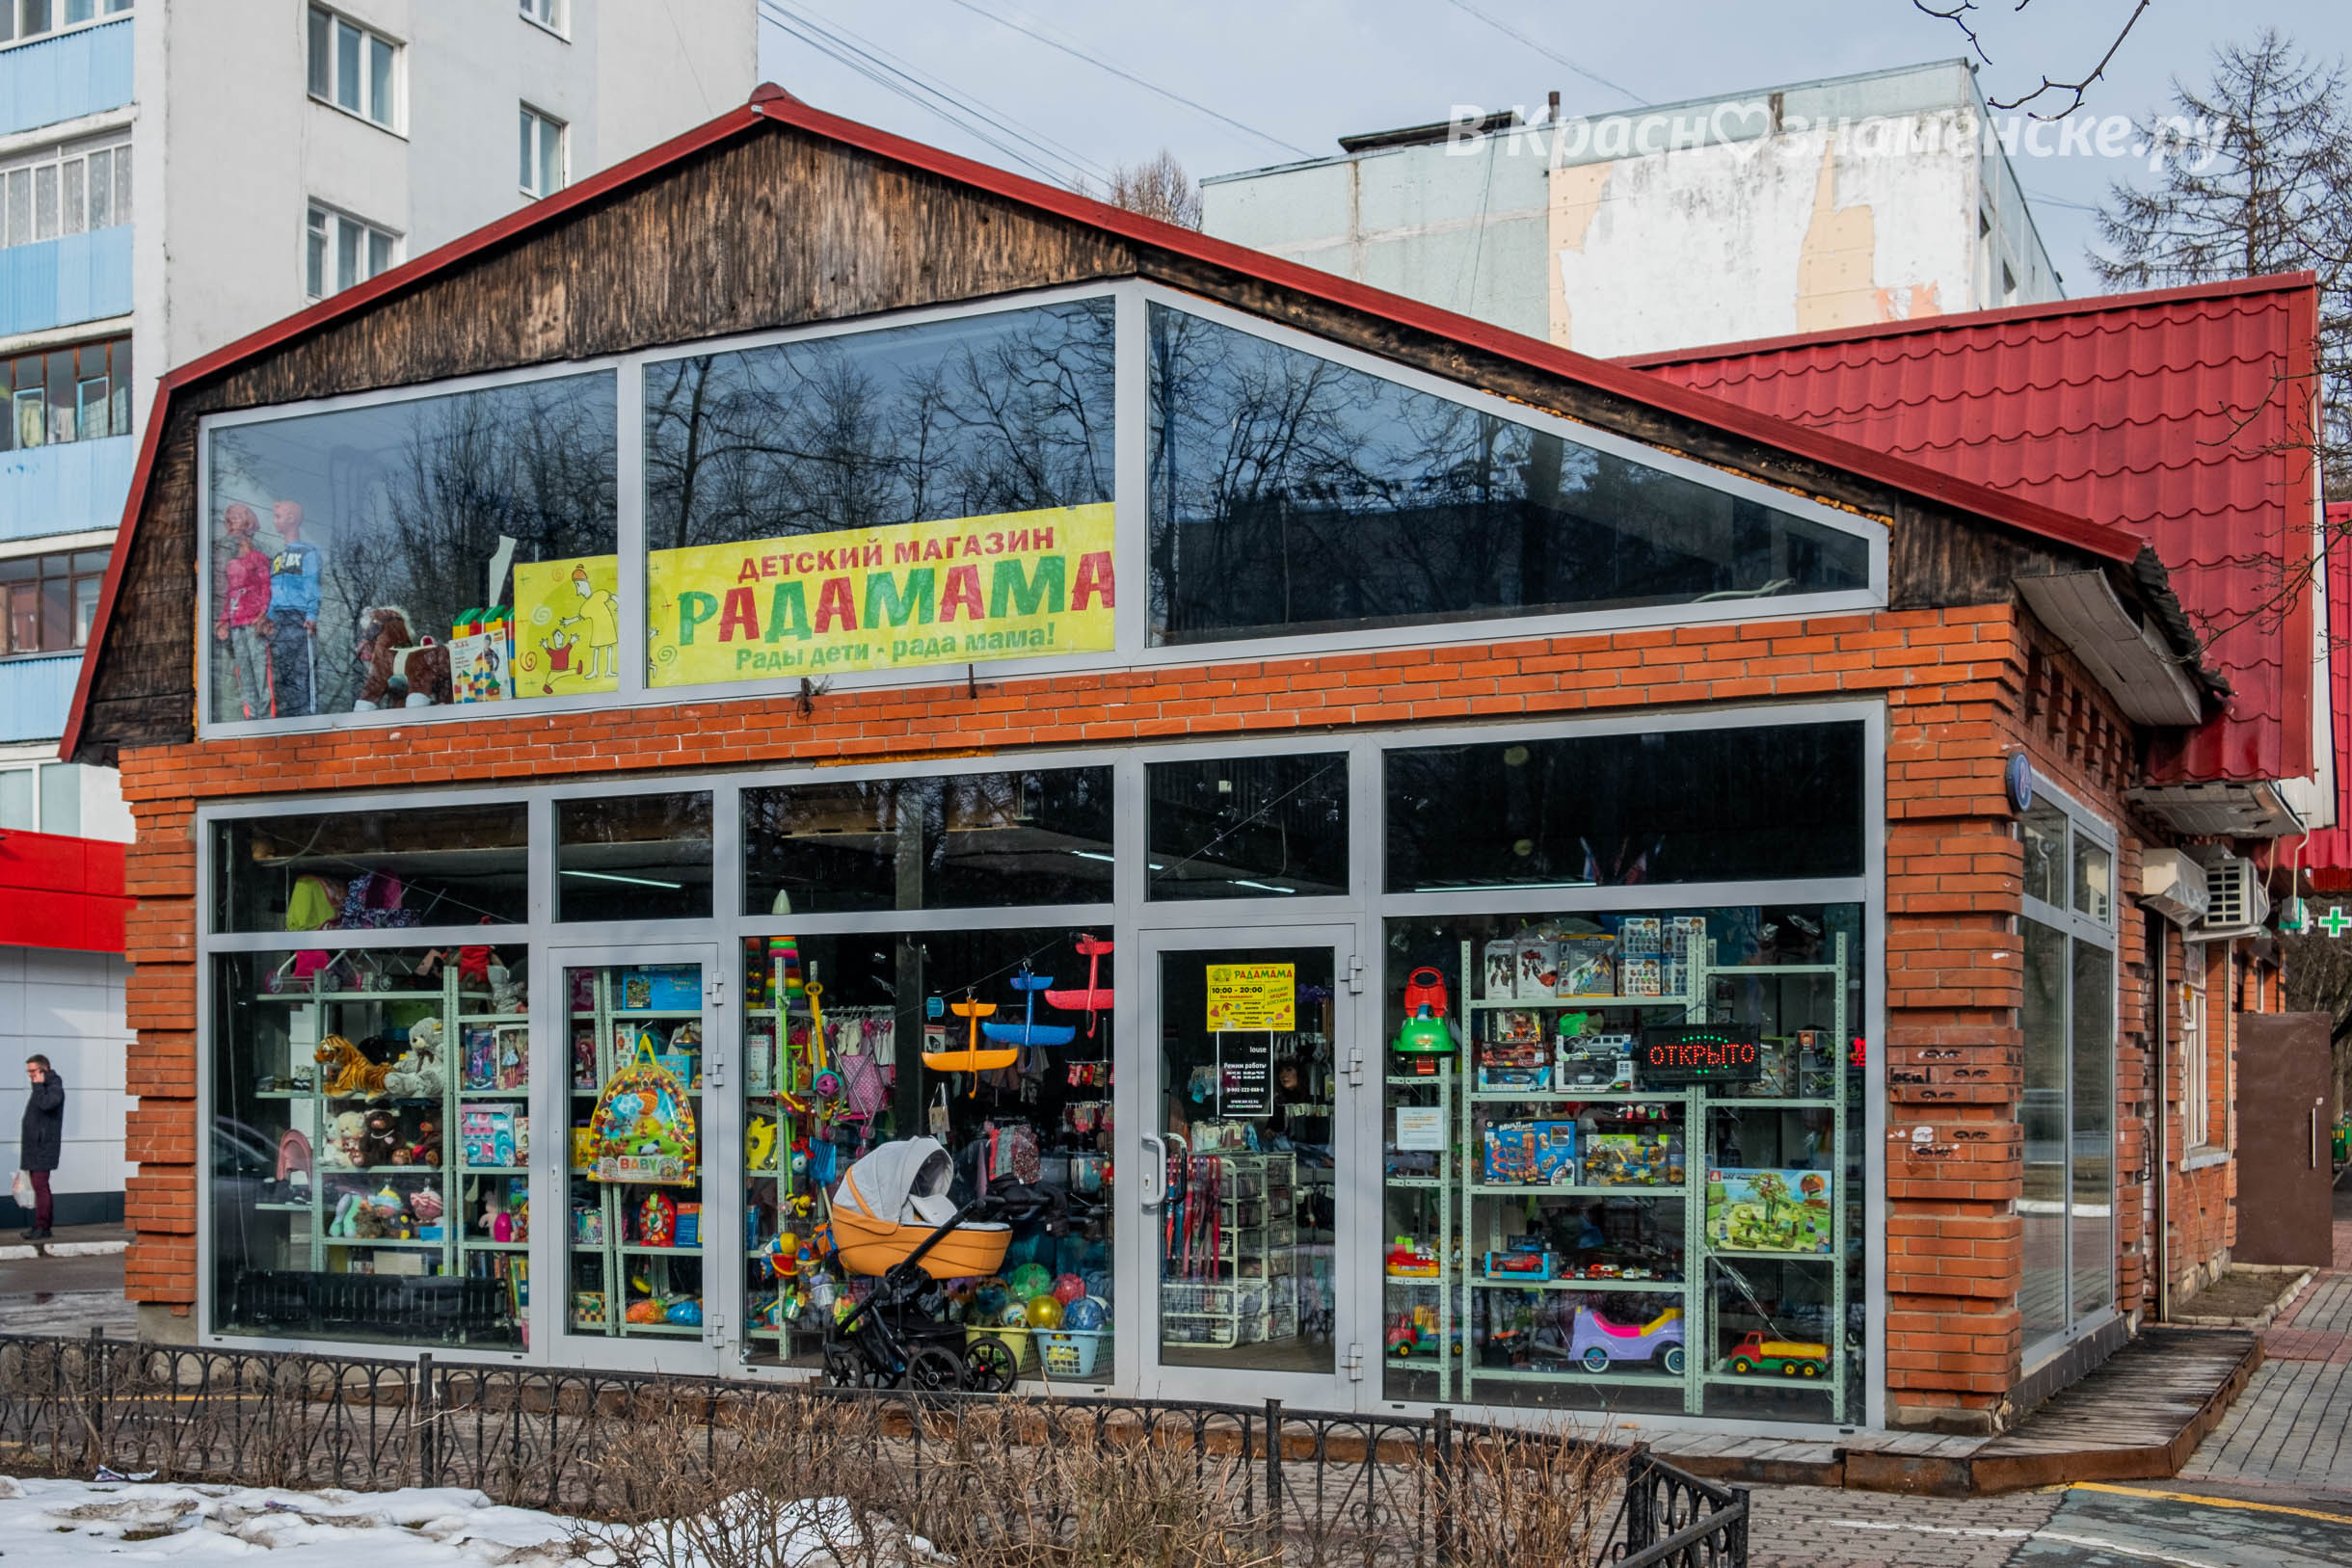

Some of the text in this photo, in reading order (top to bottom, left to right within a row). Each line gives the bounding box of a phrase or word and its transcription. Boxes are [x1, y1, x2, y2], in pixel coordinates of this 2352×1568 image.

[737, 526, 1055, 584] ДЕТСКИЙ МАГАЗИН
[677, 550, 1115, 646] РАДАМАМА
[735, 648, 804, 671] Рады
[810, 643, 869, 667] дети
[892, 634, 956, 663] рада
[965, 622, 1055, 652] мама!
[1234, 969, 1293, 980] РАДАМАМА
[1649, 1044, 1755, 1066] ОТКРЫТО
[620, 1157, 657, 1172] BABY
